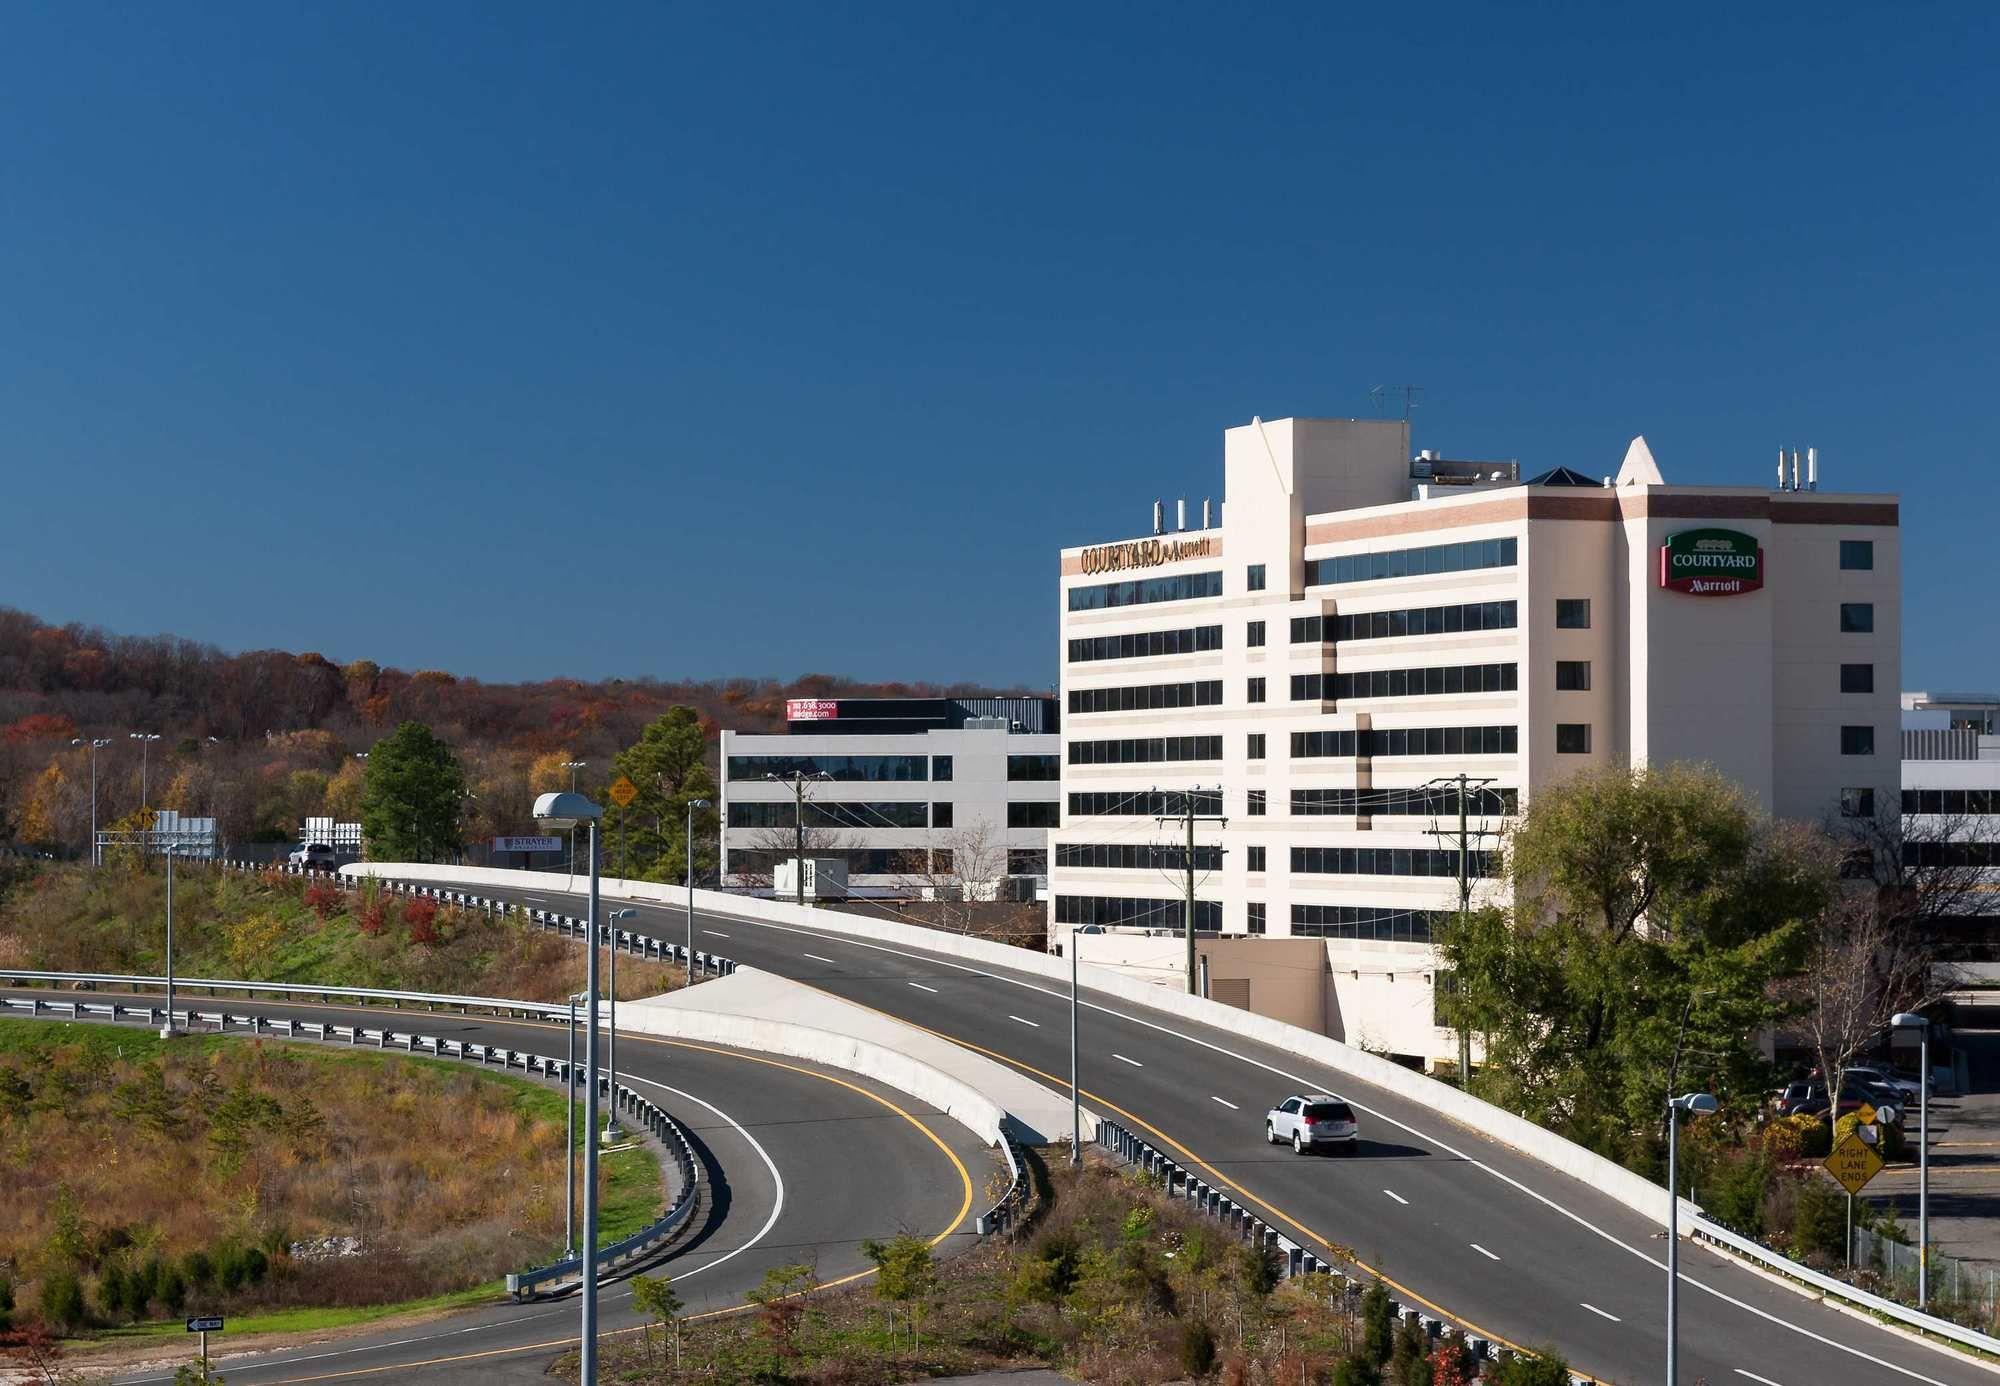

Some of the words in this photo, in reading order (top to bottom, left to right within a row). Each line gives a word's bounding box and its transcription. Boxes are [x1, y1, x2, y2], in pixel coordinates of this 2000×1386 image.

[1081, 539, 1163, 571] COURTYARD
[1672, 554, 1756, 568] COURTYARD
[1689, 580, 1740, 593] Marriott
[513, 837, 553, 846] STRAYER
[1839, 1148, 1868, 1158] RIGHT
[1840, 1160, 1867, 1170] LANE
[1840, 1172, 1867, 1181] ENDS
